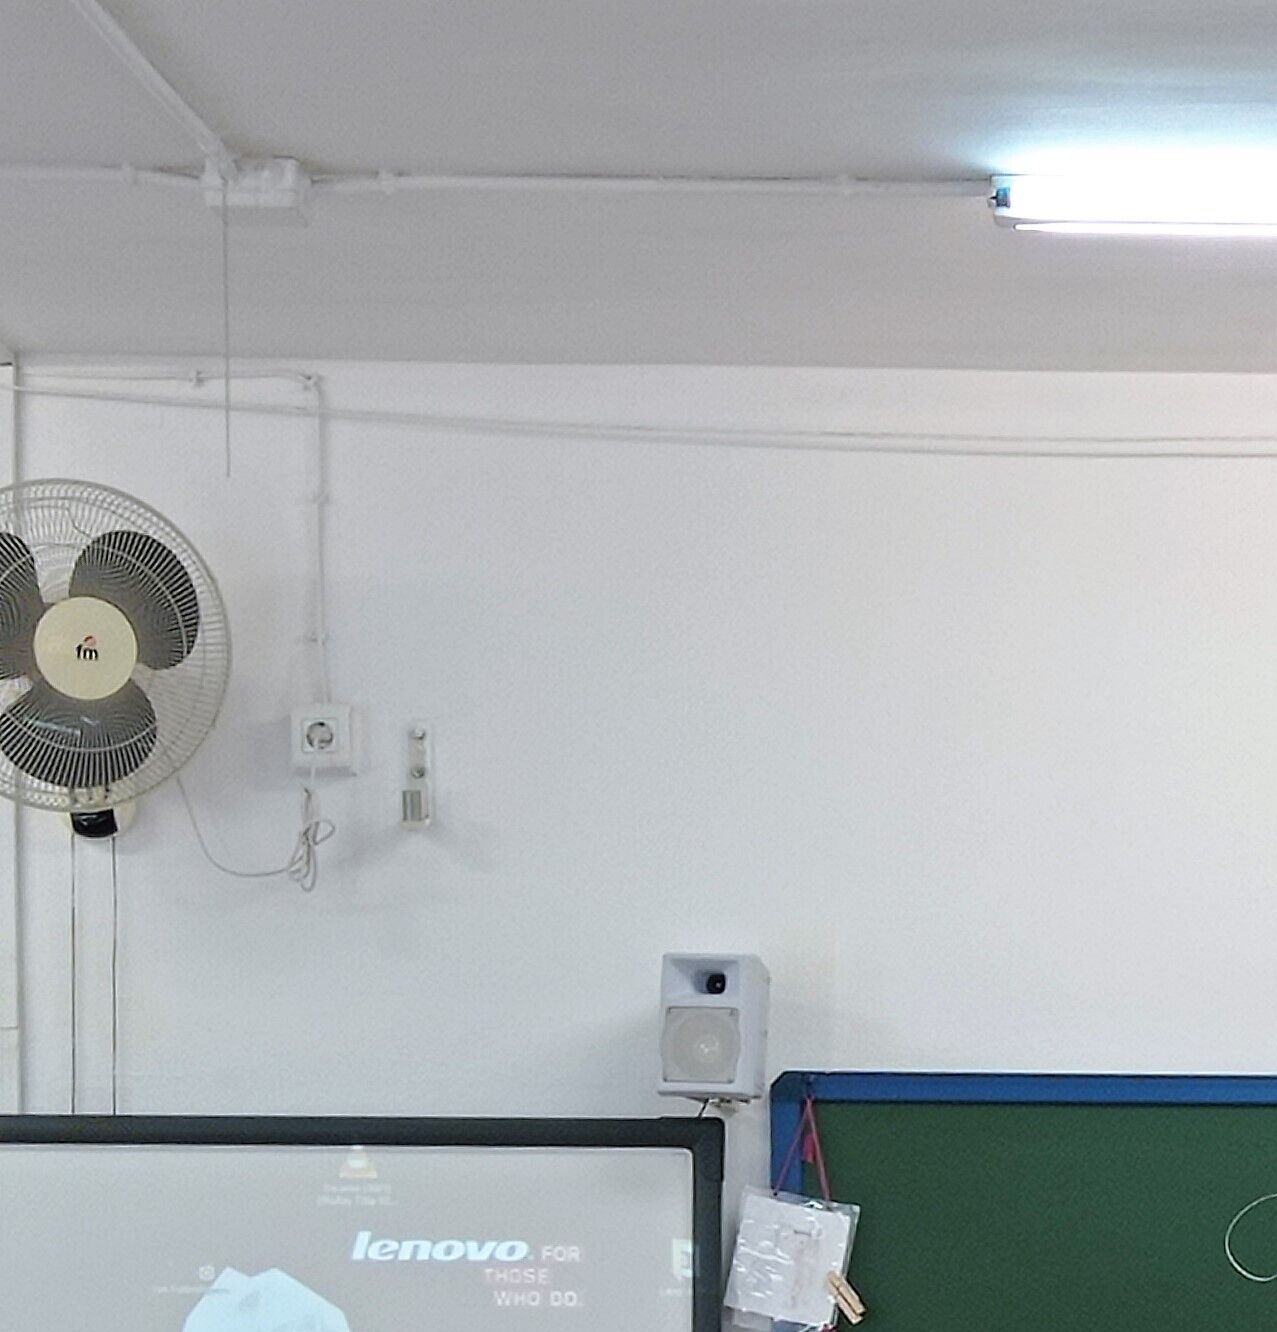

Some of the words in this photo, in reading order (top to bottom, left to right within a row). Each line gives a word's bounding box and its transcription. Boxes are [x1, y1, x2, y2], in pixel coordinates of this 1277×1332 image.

[541, 1246, 581, 1263] FOR
[484, 1268, 549, 1285] THOSE
[493, 1291, 541, 1307] WHO
